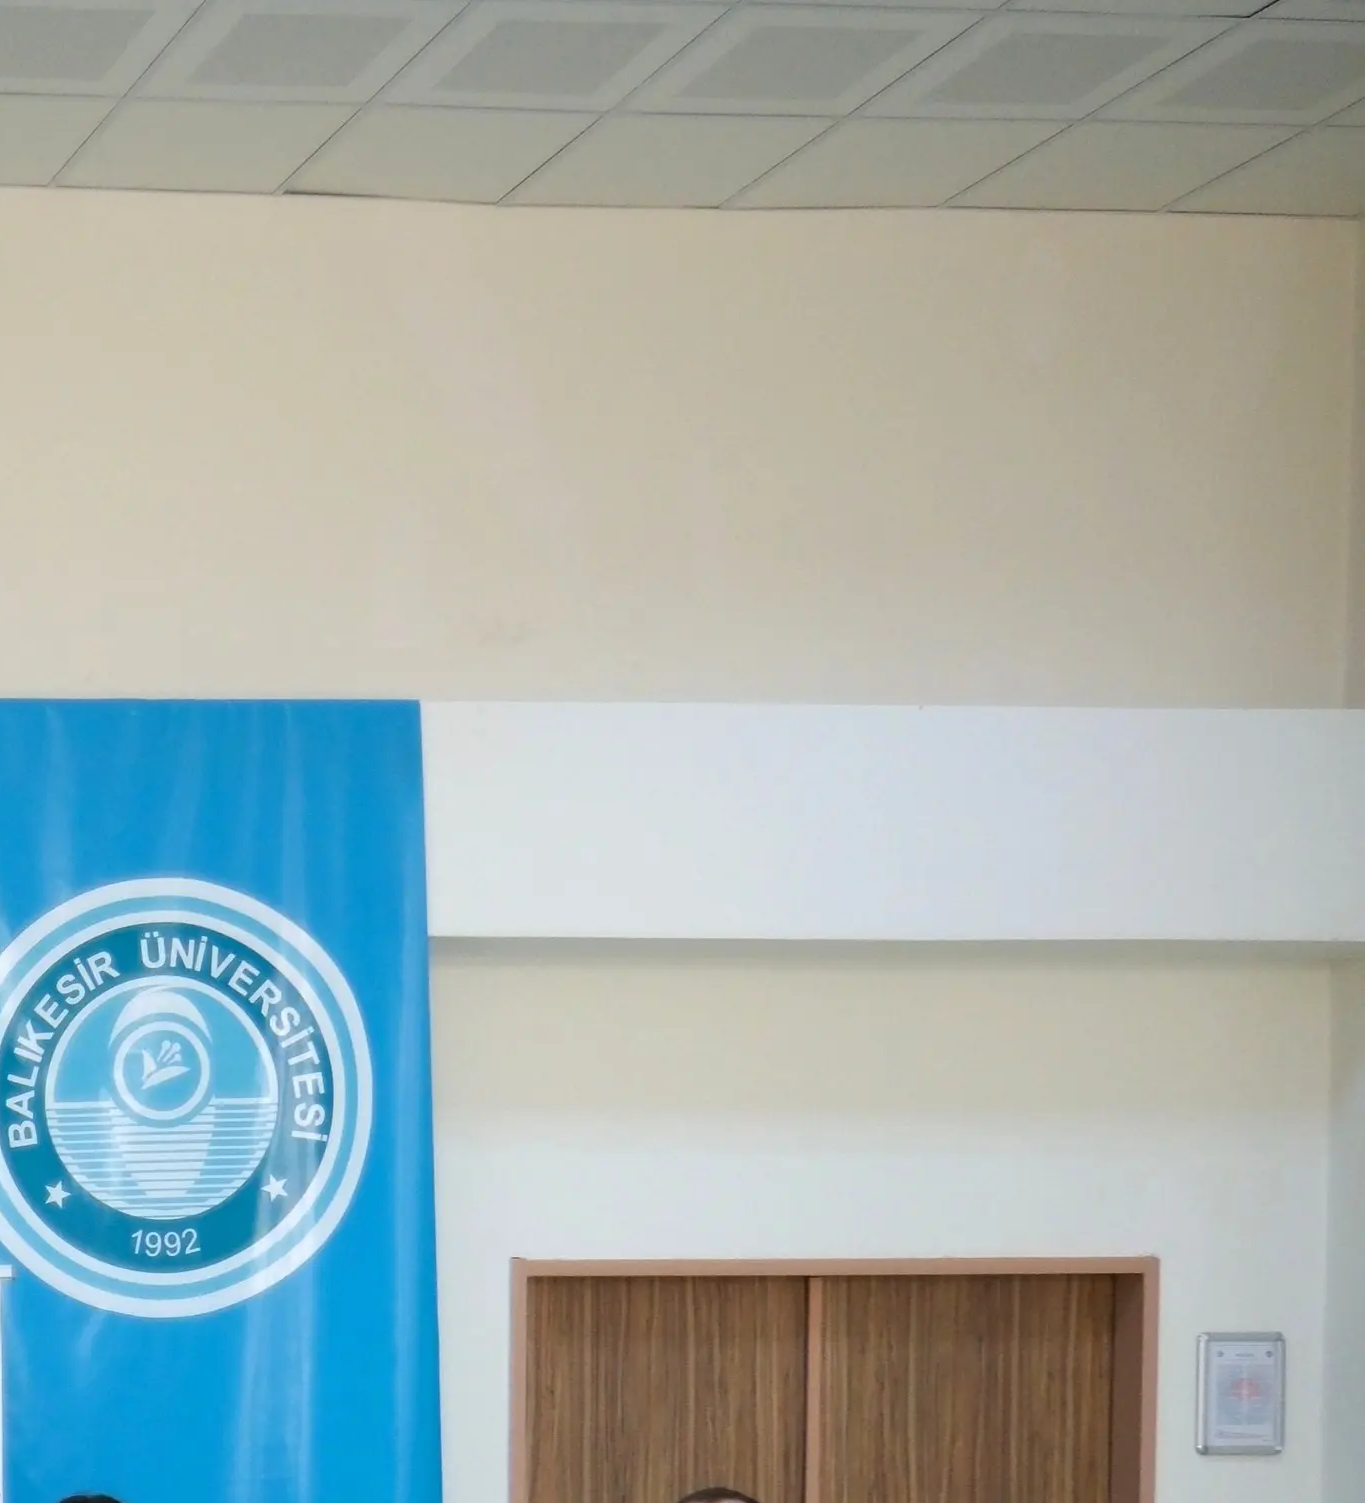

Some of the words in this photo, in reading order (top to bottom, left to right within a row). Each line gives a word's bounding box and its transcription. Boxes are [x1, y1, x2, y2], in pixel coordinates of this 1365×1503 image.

[6, 950, 120, 1149] BALIKESİR
[140, 931, 328, 1144] ÜNİVERSİTESİ
[131, 1228, 201, 1257] 1992
